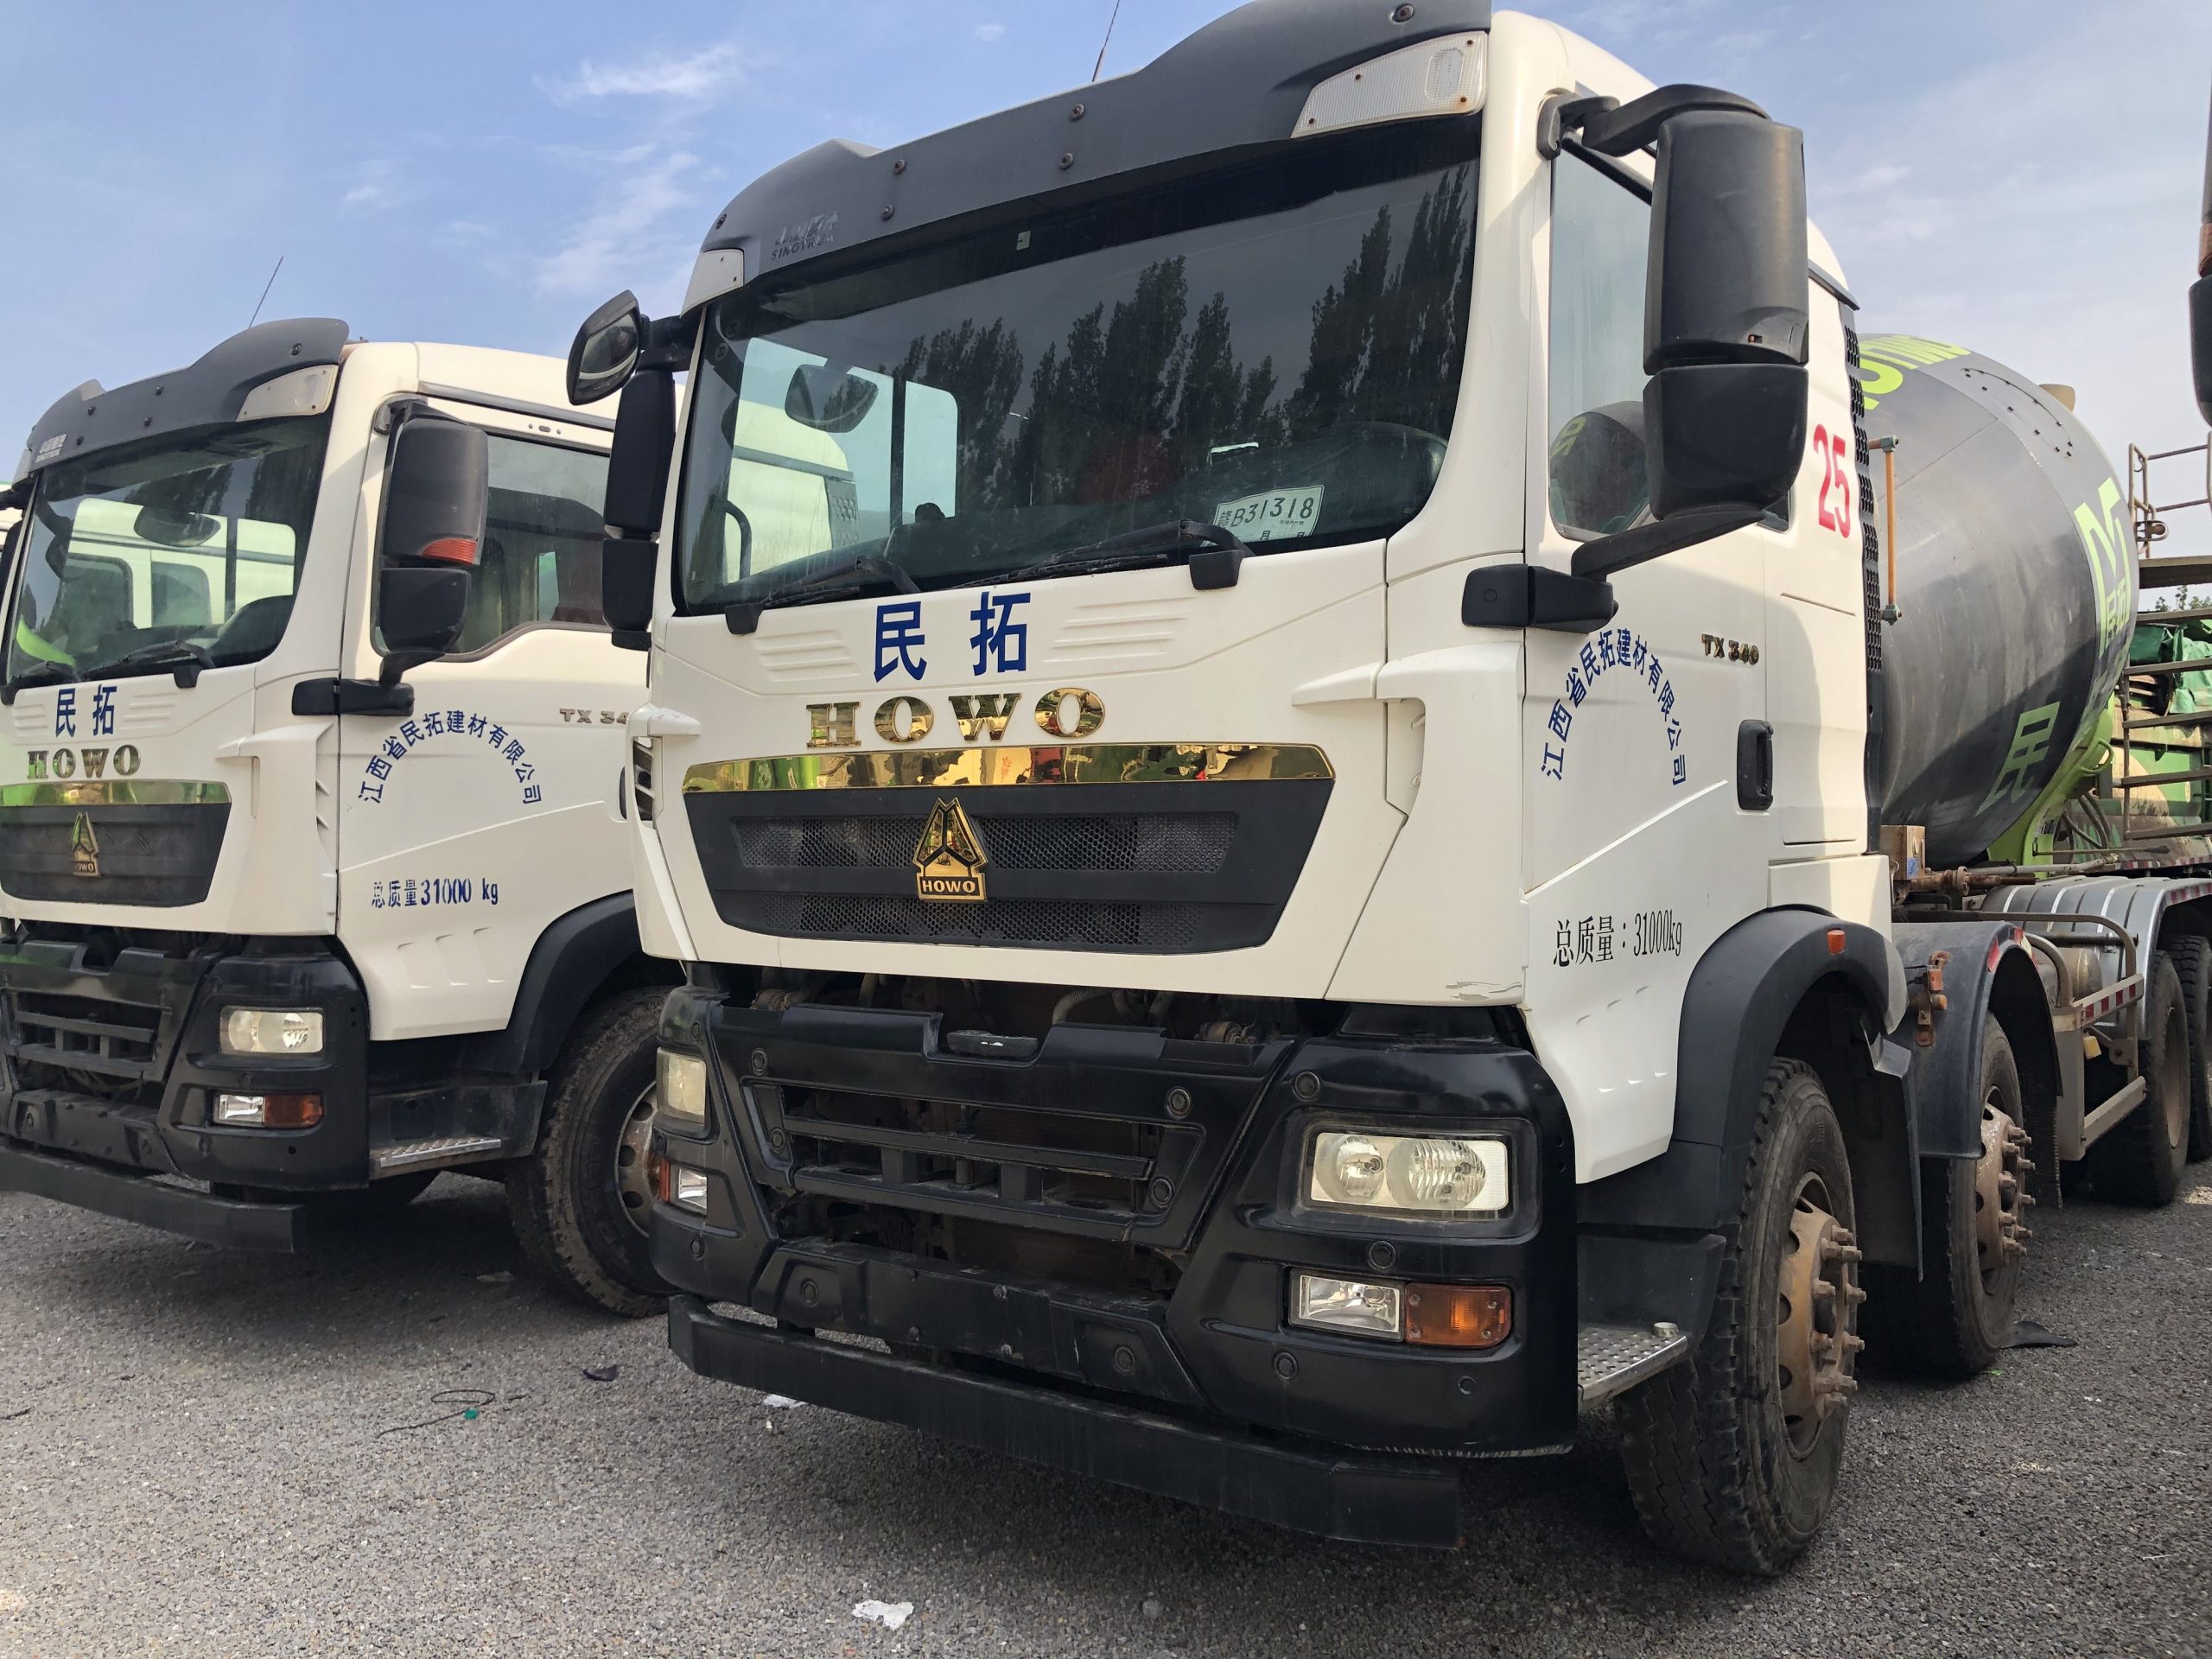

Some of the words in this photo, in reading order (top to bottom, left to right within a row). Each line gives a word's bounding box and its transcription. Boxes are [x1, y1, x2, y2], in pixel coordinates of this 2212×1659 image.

[1813, 423, 1851, 538] 25
[874, 591, 1031, 683] 民拓
[1701, 633, 1726, 658] TX
[1728, 639, 1760, 664] 340
[55, 684, 118, 738] 民拓
[559, 708, 592, 723] TX
[806, 687, 1106, 747] HOWO
[1541, 627, 1687, 785] 江西省民拓建材有限公司
[27, 744, 142, 779] HOWO
[358, 710, 542, 804] 江西省民拓建材有限公司
[1974, 702, 2061, 817] 民
[73, 862, 94, 873] OWO
[482, 877, 499, 906] kg
[922, 880, 976, 894] HOWO
